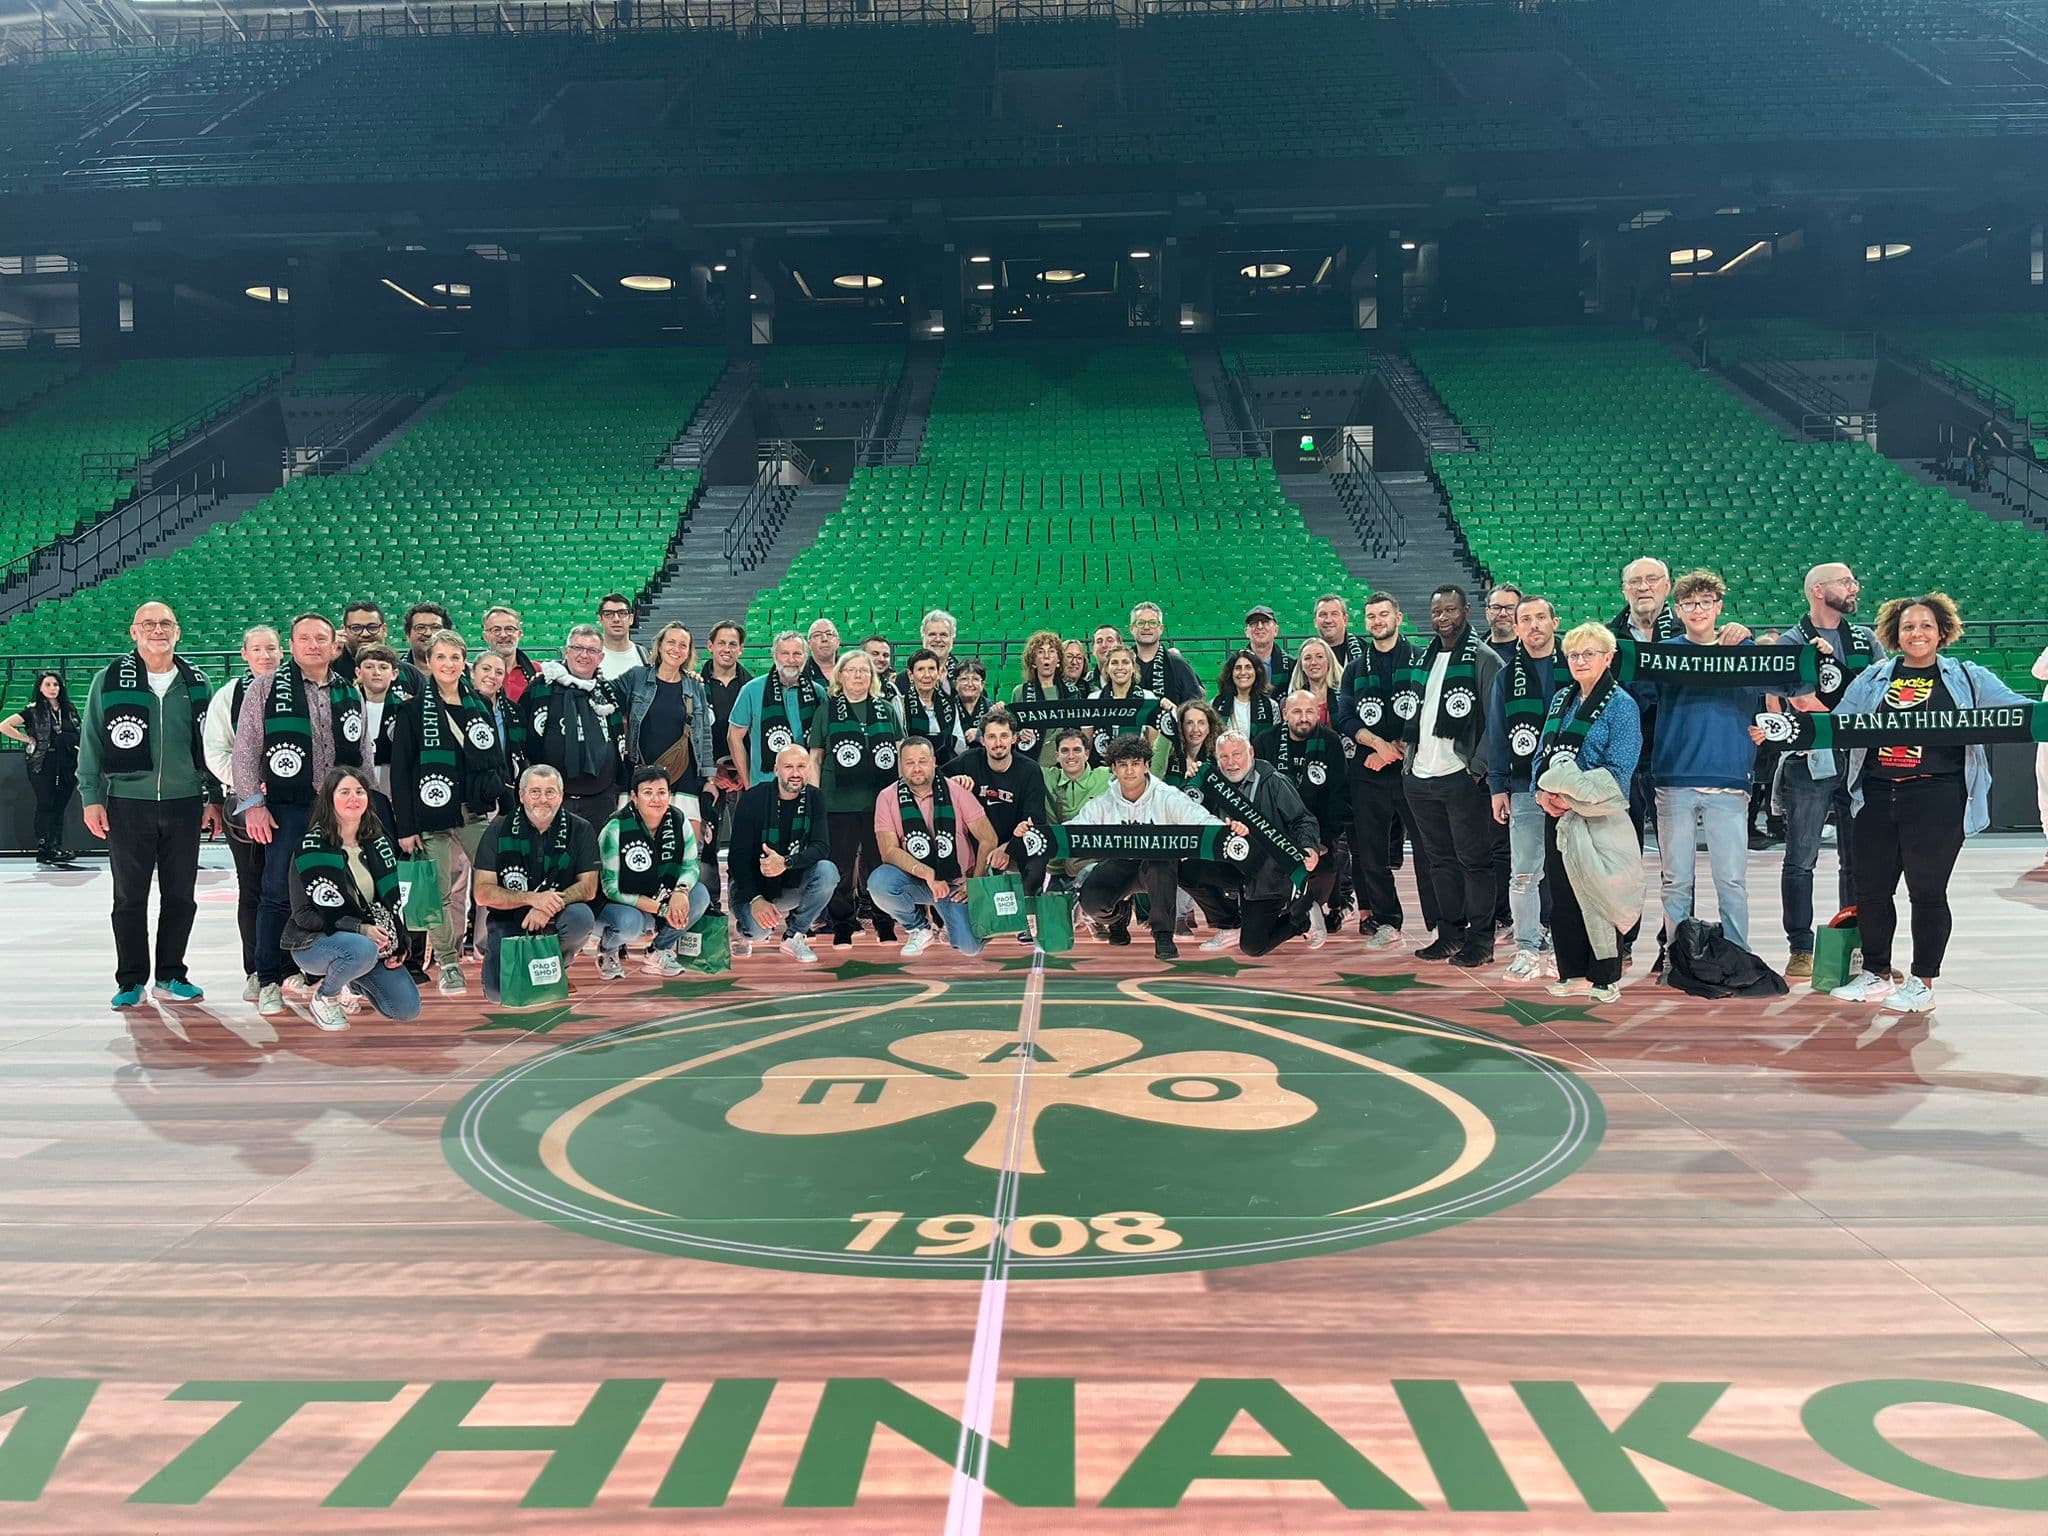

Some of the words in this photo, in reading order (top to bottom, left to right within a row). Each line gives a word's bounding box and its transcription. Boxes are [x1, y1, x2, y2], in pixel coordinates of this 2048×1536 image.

[1640, 653, 1795, 673] PANATHINAIKOS
[1017, 708, 1137, 723] PANATHINAIKOS
[1839, 709, 2023, 730] PANATHINAIKOS
[1207, 773, 1306, 862] PANATHINAIKOS
[1071, 834, 1198, 850] PANATHINAIKOS
[534, 967, 558, 977] SHOP
[844, 1211, 1183, 1256] 1908
